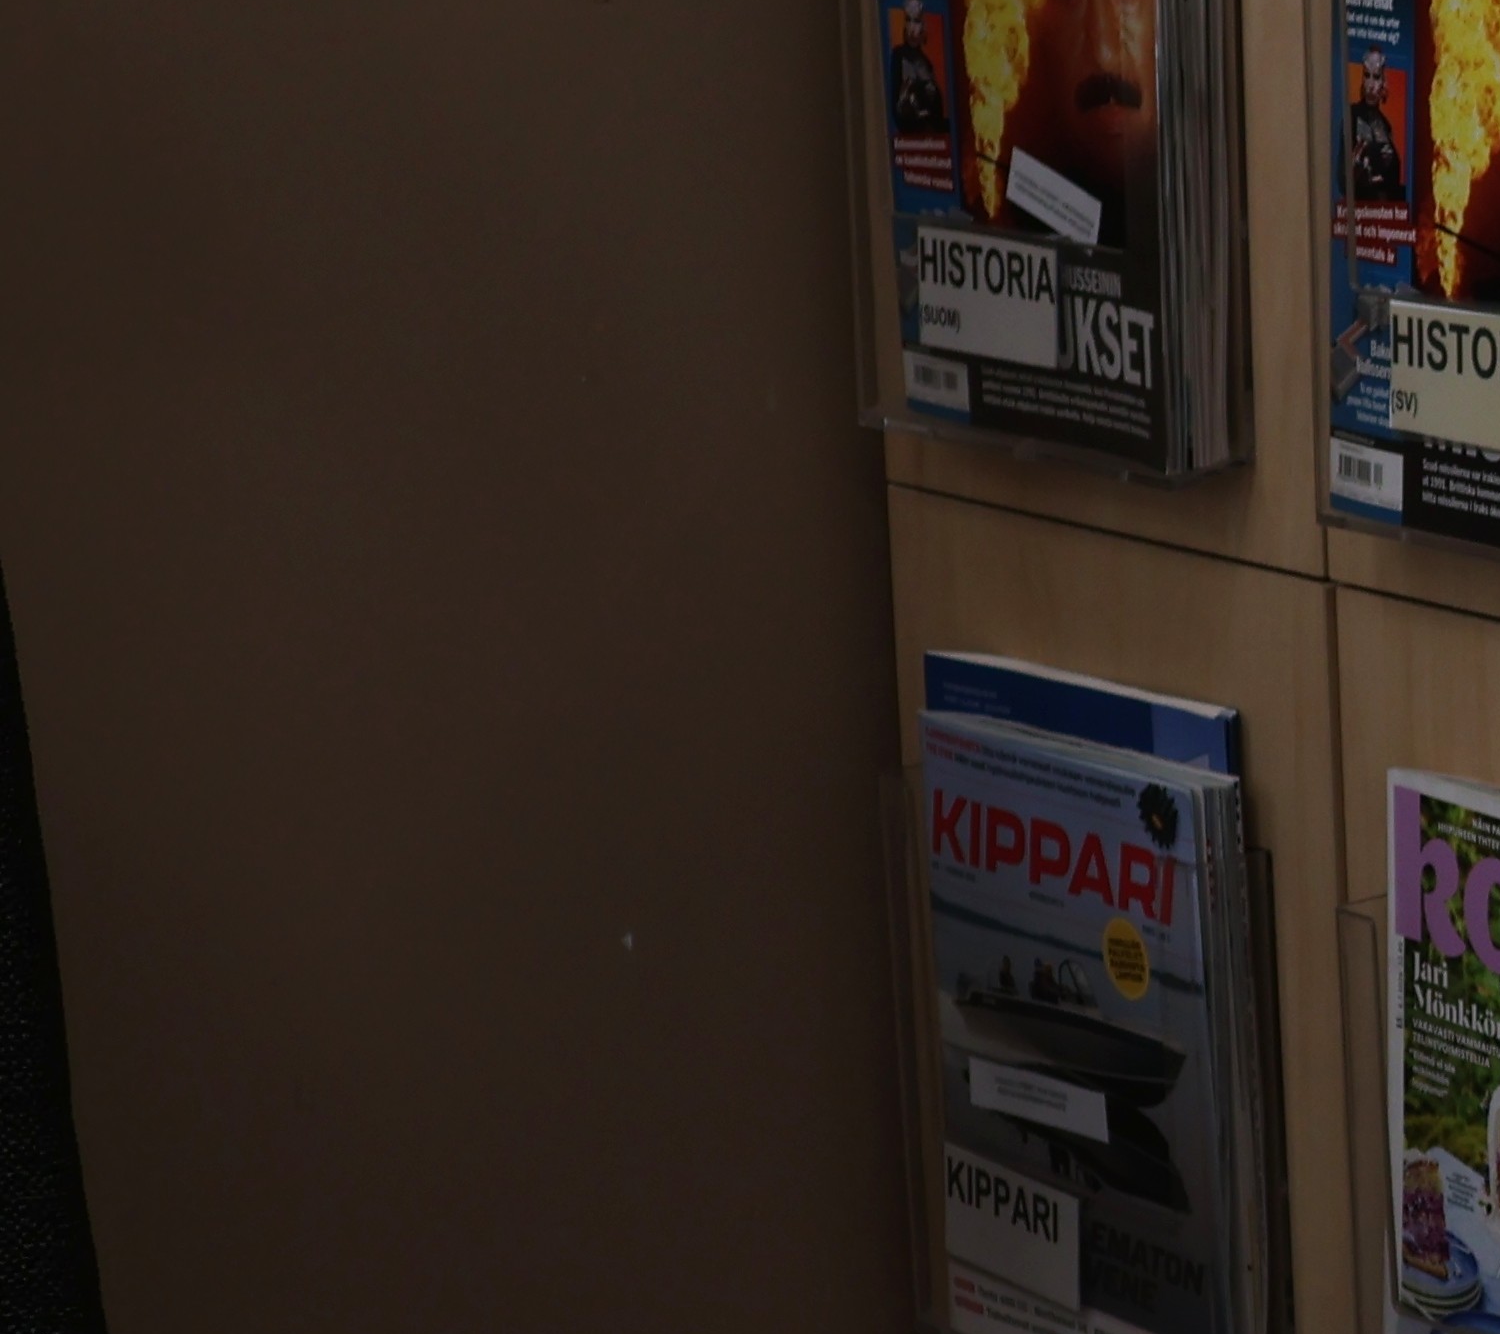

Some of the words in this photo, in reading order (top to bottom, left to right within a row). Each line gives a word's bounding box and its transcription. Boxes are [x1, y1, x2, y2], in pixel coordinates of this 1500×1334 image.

[919, 237, 1056, 304] HISTORIA
[919, 303, 961, 333] (SUOM)
[1391, 389, 1418, 418] (SV)
[930, 788, 1176, 927] KIPPARI
[1413, 952, 1448, 990] Jari
[947, 1155, 1060, 1245] KIPPARI
